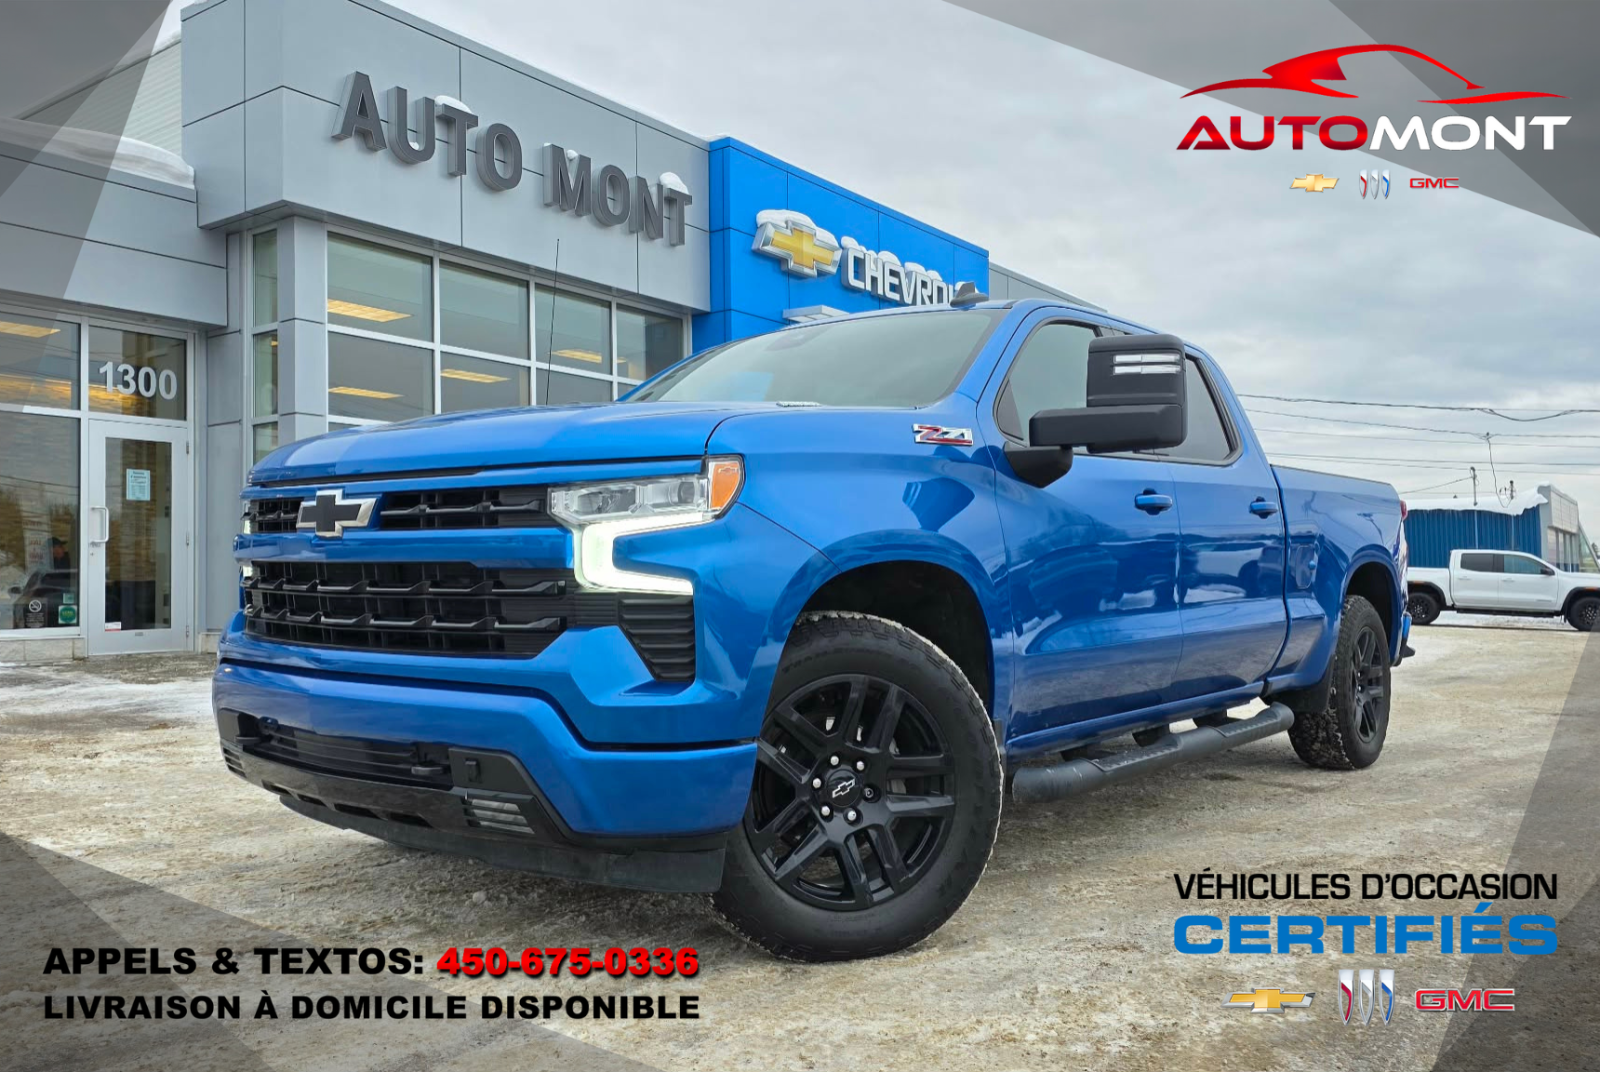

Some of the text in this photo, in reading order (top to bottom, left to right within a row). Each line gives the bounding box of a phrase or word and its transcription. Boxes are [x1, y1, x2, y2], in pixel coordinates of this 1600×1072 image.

[332, 71, 692, 246] AUTO MONT
[99, 361, 178, 400] 1300
[912, 423, 974, 446] Z71
